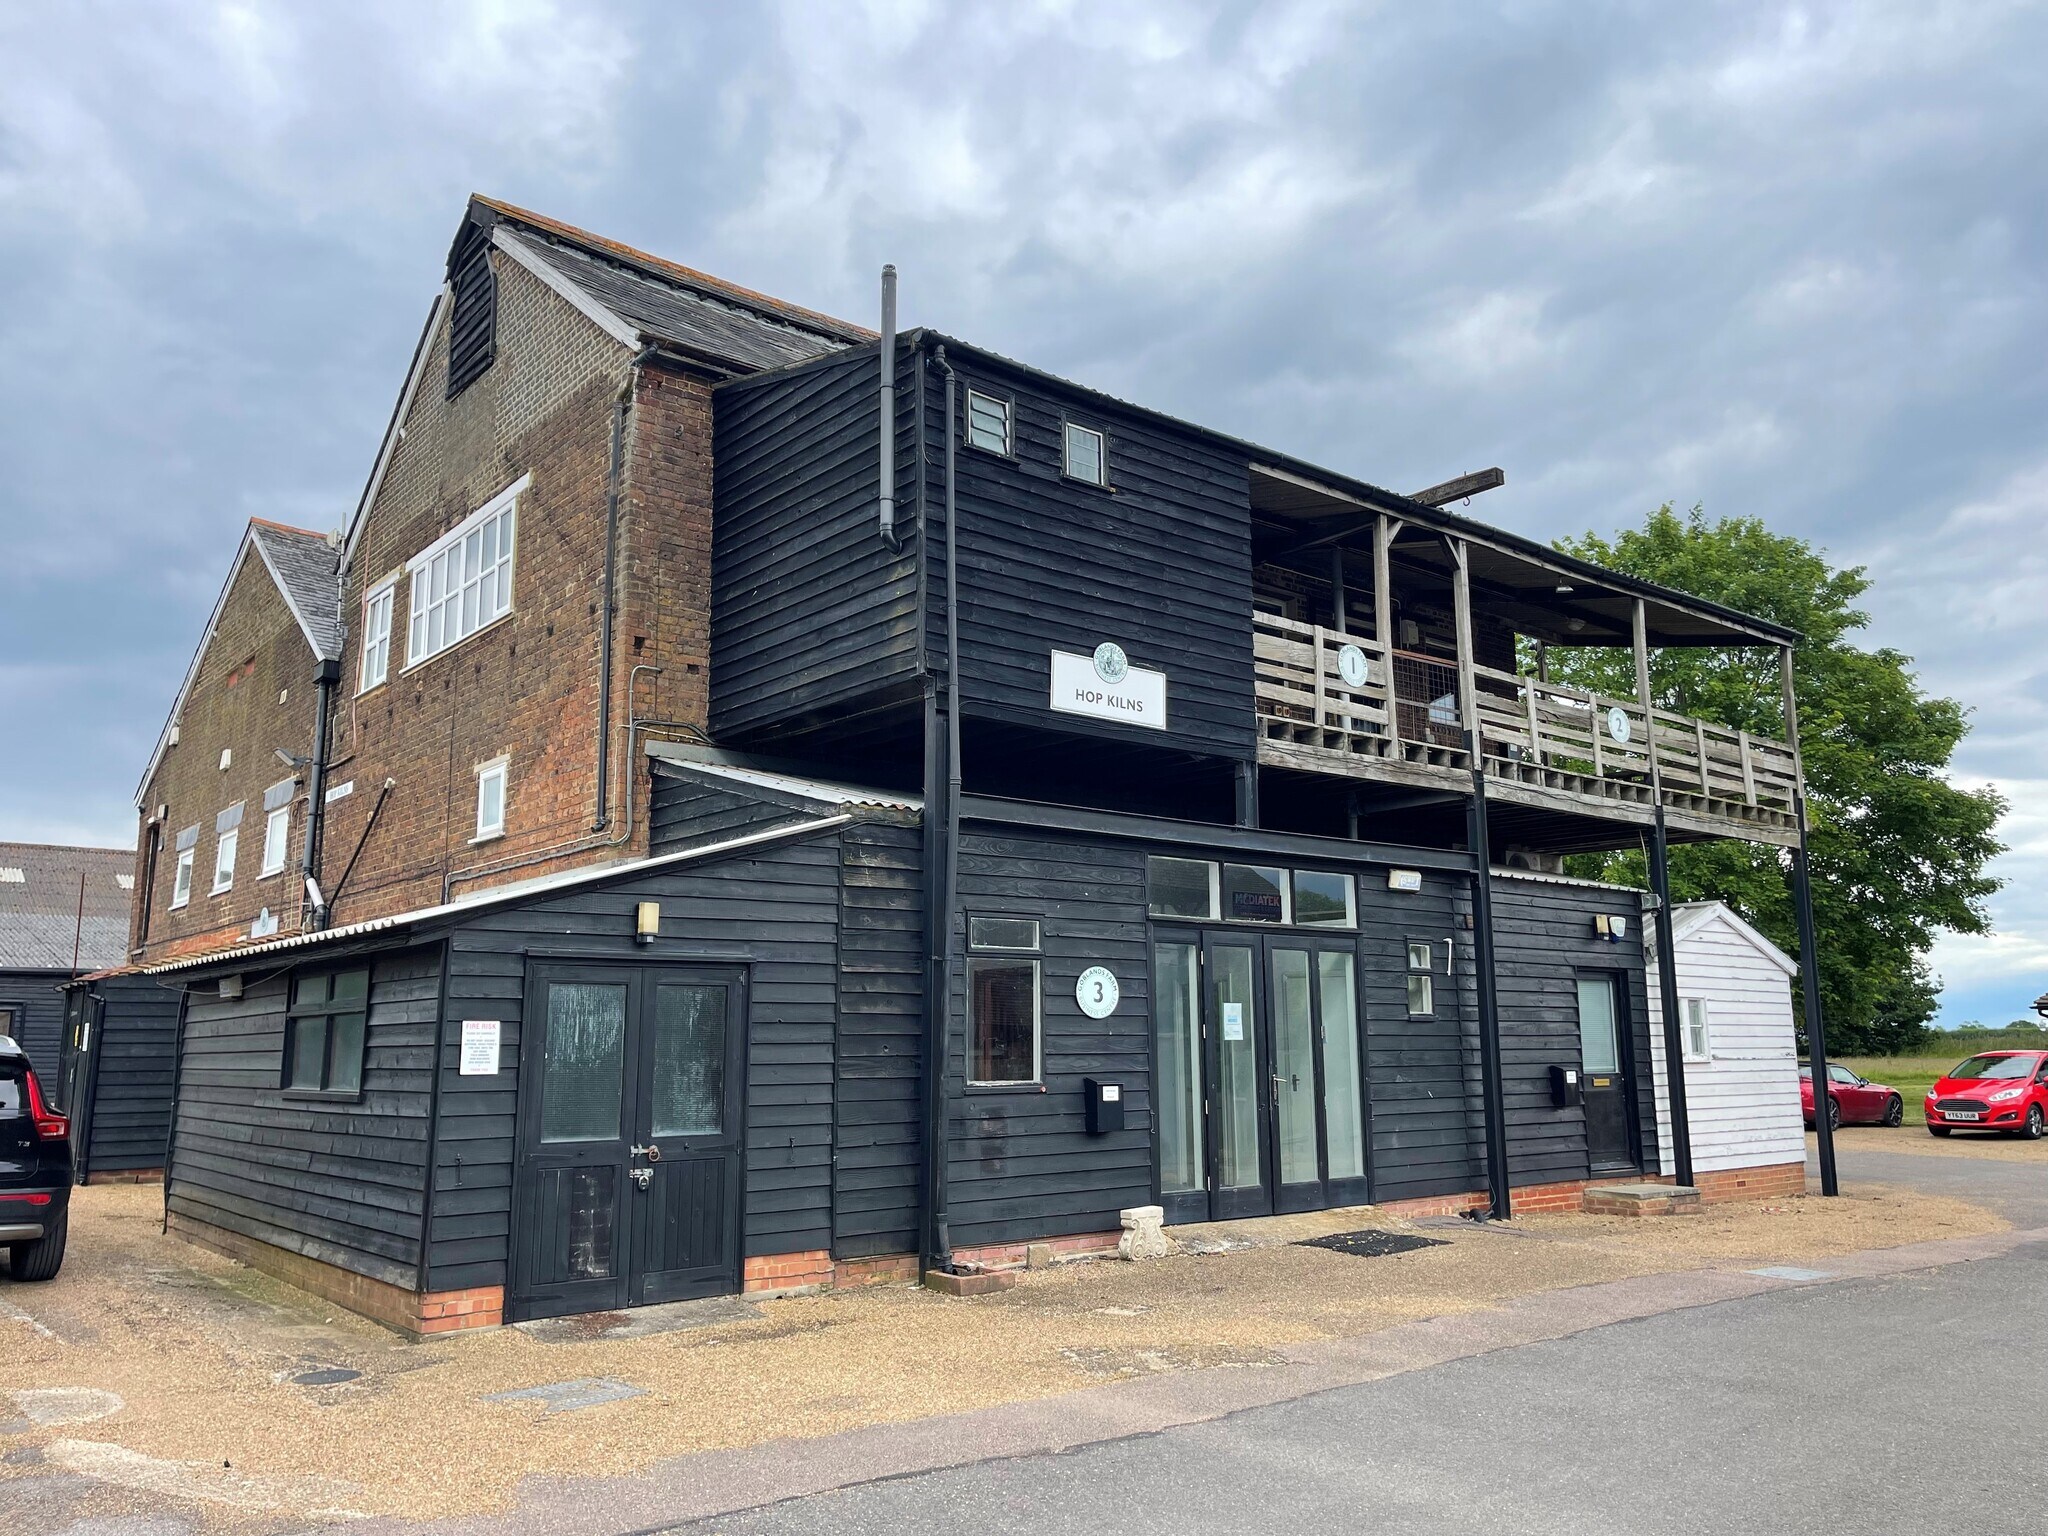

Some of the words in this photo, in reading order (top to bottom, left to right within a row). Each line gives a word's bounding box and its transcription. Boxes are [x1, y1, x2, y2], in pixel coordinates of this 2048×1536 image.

[1075, 688, 1103, 704] HOP
[1107, 694, 1143, 712] KILNS
[1615, 717, 1623, 733] 2
[1078, 968, 1105, 992] GOBLANDS
[1105, 972, 1117, 992] FARM
[1093, 981, 1104, 1003] 3
[465, 1022, 480, 1030] FIRE
[481, 1022, 497, 1030] RISK
